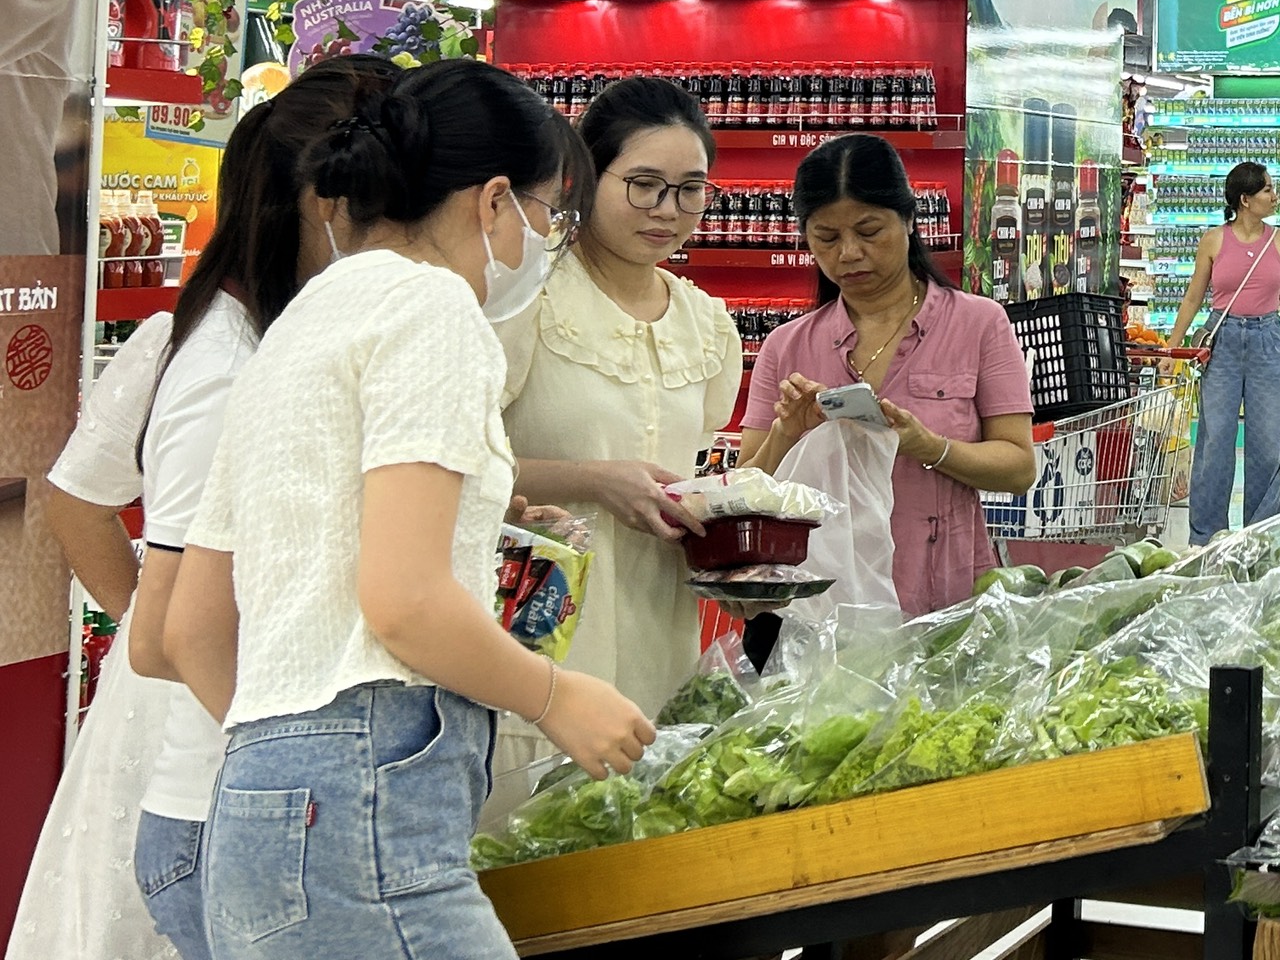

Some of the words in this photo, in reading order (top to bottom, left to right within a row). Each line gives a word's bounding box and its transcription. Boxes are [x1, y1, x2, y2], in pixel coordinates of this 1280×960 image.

[303, 0, 374, 31] AUSTRALIA
[772, 134, 787, 146] GIA
[144, 175, 178, 189] CAM
[771, 253, 784, 265] GIA
[19, 280, 57, 310] BẢN
